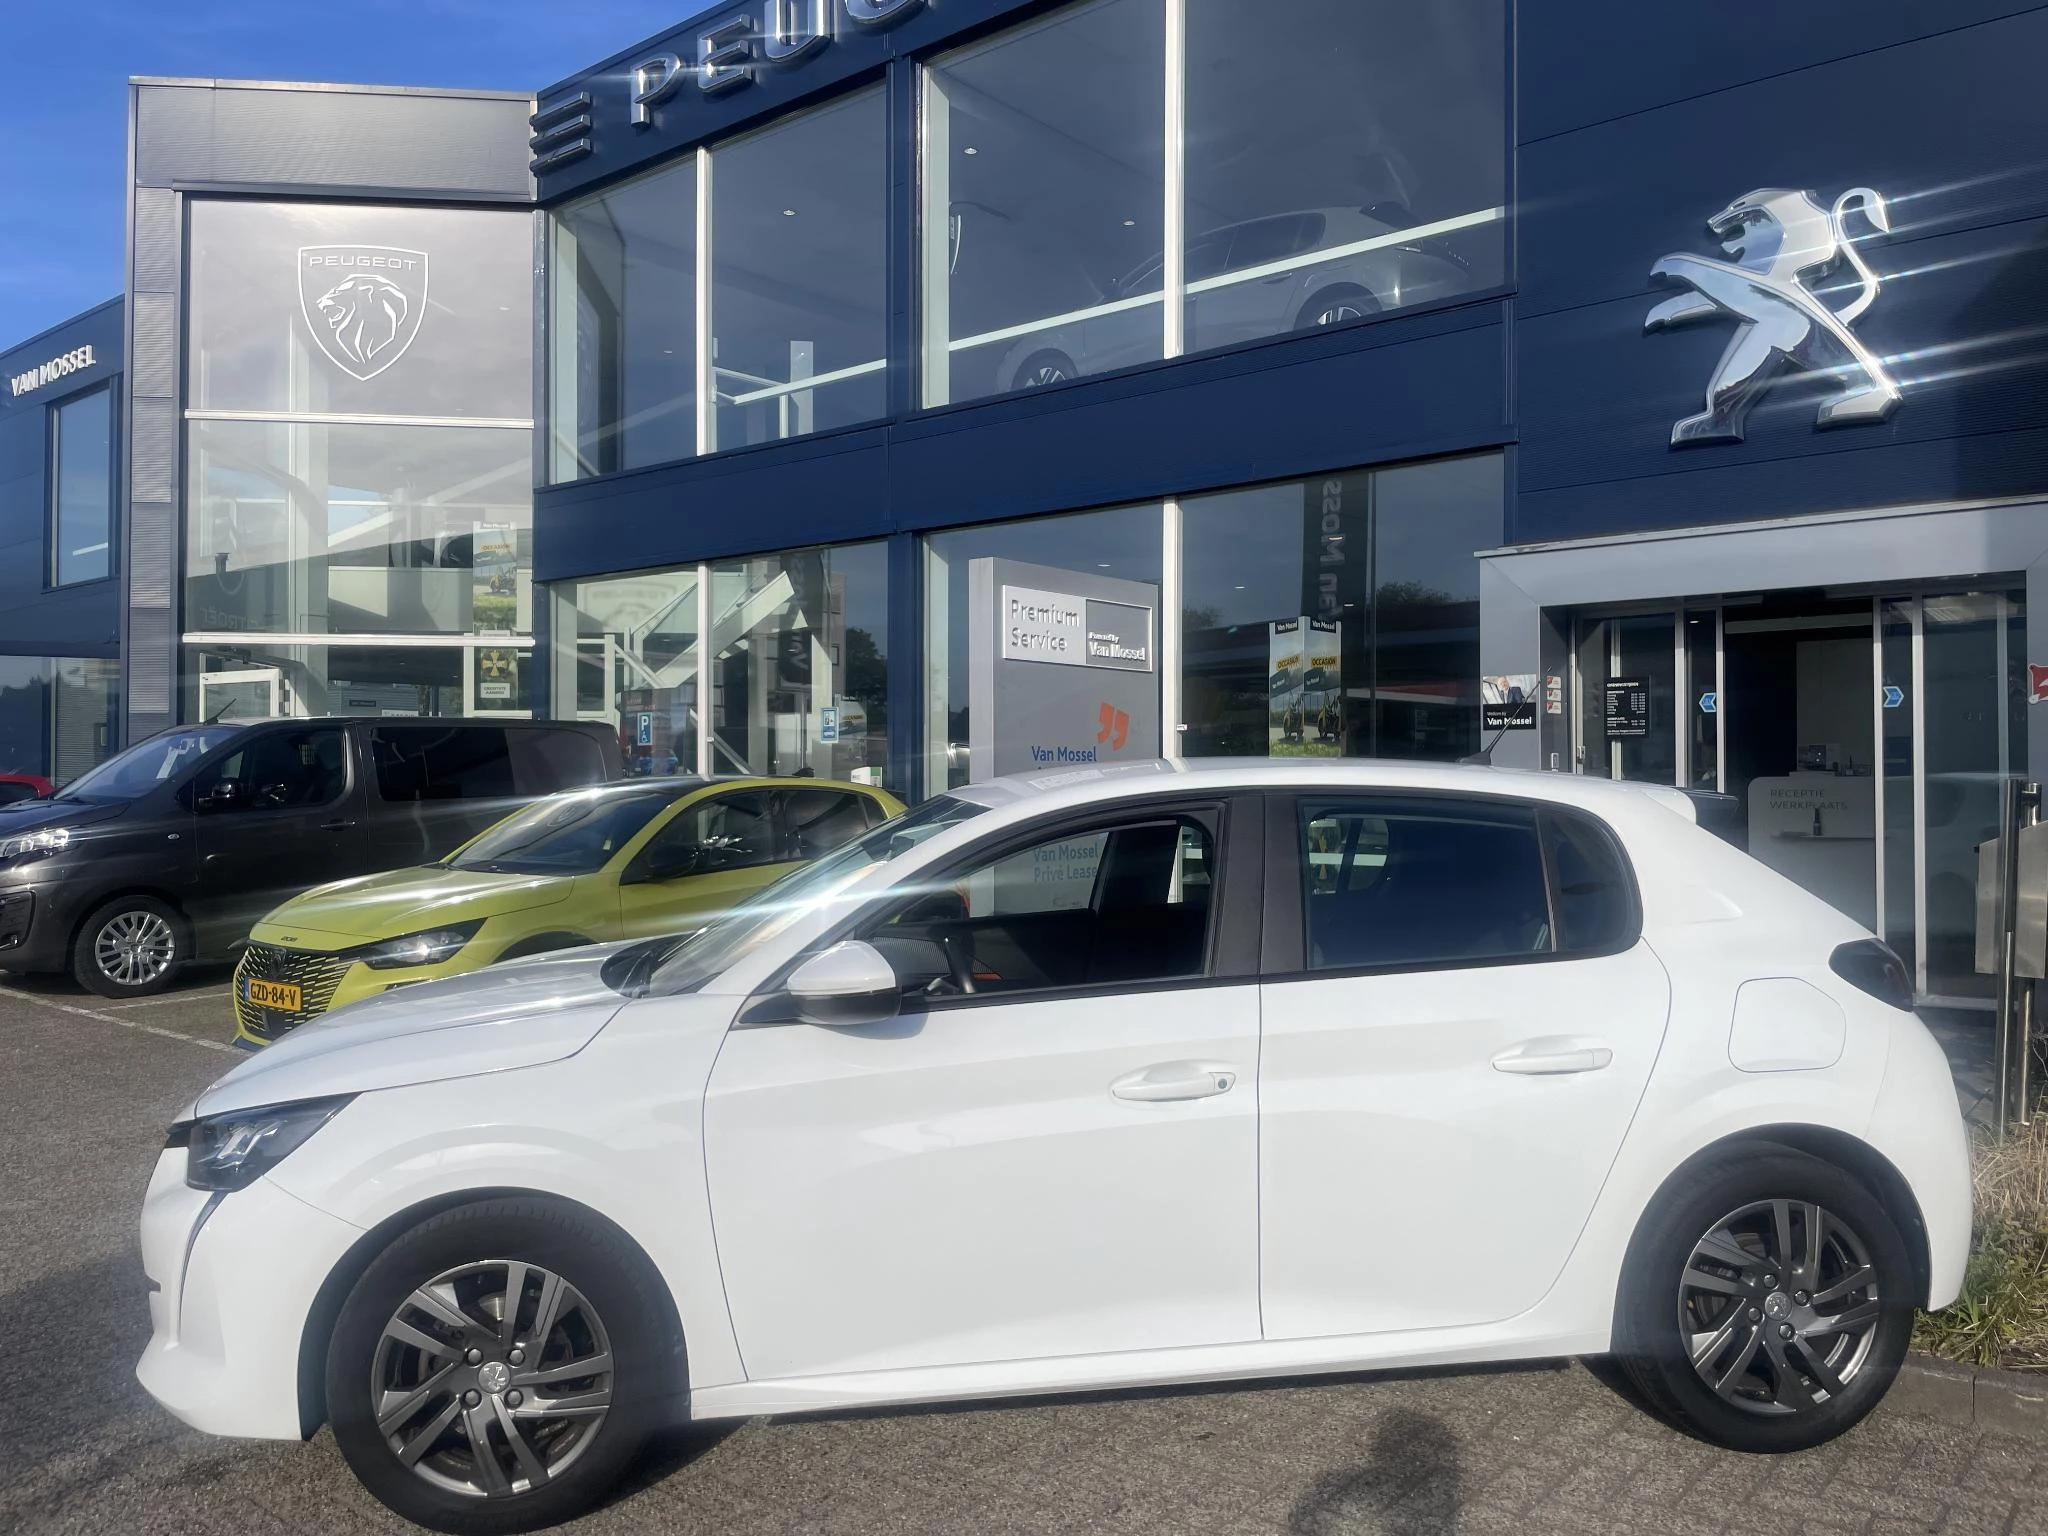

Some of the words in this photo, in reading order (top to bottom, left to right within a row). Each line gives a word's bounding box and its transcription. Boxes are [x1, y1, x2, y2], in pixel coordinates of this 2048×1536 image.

[310, 255, 416, 271] PEUGEOT
[11, 369, 39, 397] VAN
[40, 345, 96, 385] MOSSEL
[1011, 599, 1080, 627] Premium
[1011, 627, 1068, 651] Service
[1089, 641, 1109, 657] Van
[1110, 643, 1146, 661] Mossel
[1312, 657, 1336, 666] OCCASION
[641, 715, 649, 731] P
[1487, 717, 1502, 726] Van
[1504, 716, 1532, 725] Mossel
[1031, 745, 1054, 761] Van
[1057, 745, 1097, 762] Mossel
[1770, 789, 1825, 798] RECEPTIE
[1033, 846, 1056, 862] Van
[1058, 841, 1099, 860] Mossel
[1034, 864, 1064, 882] Privé
[1066, 864, 1097, 880] Lease
[250, 982, 297, 1007] GZD-84-V
